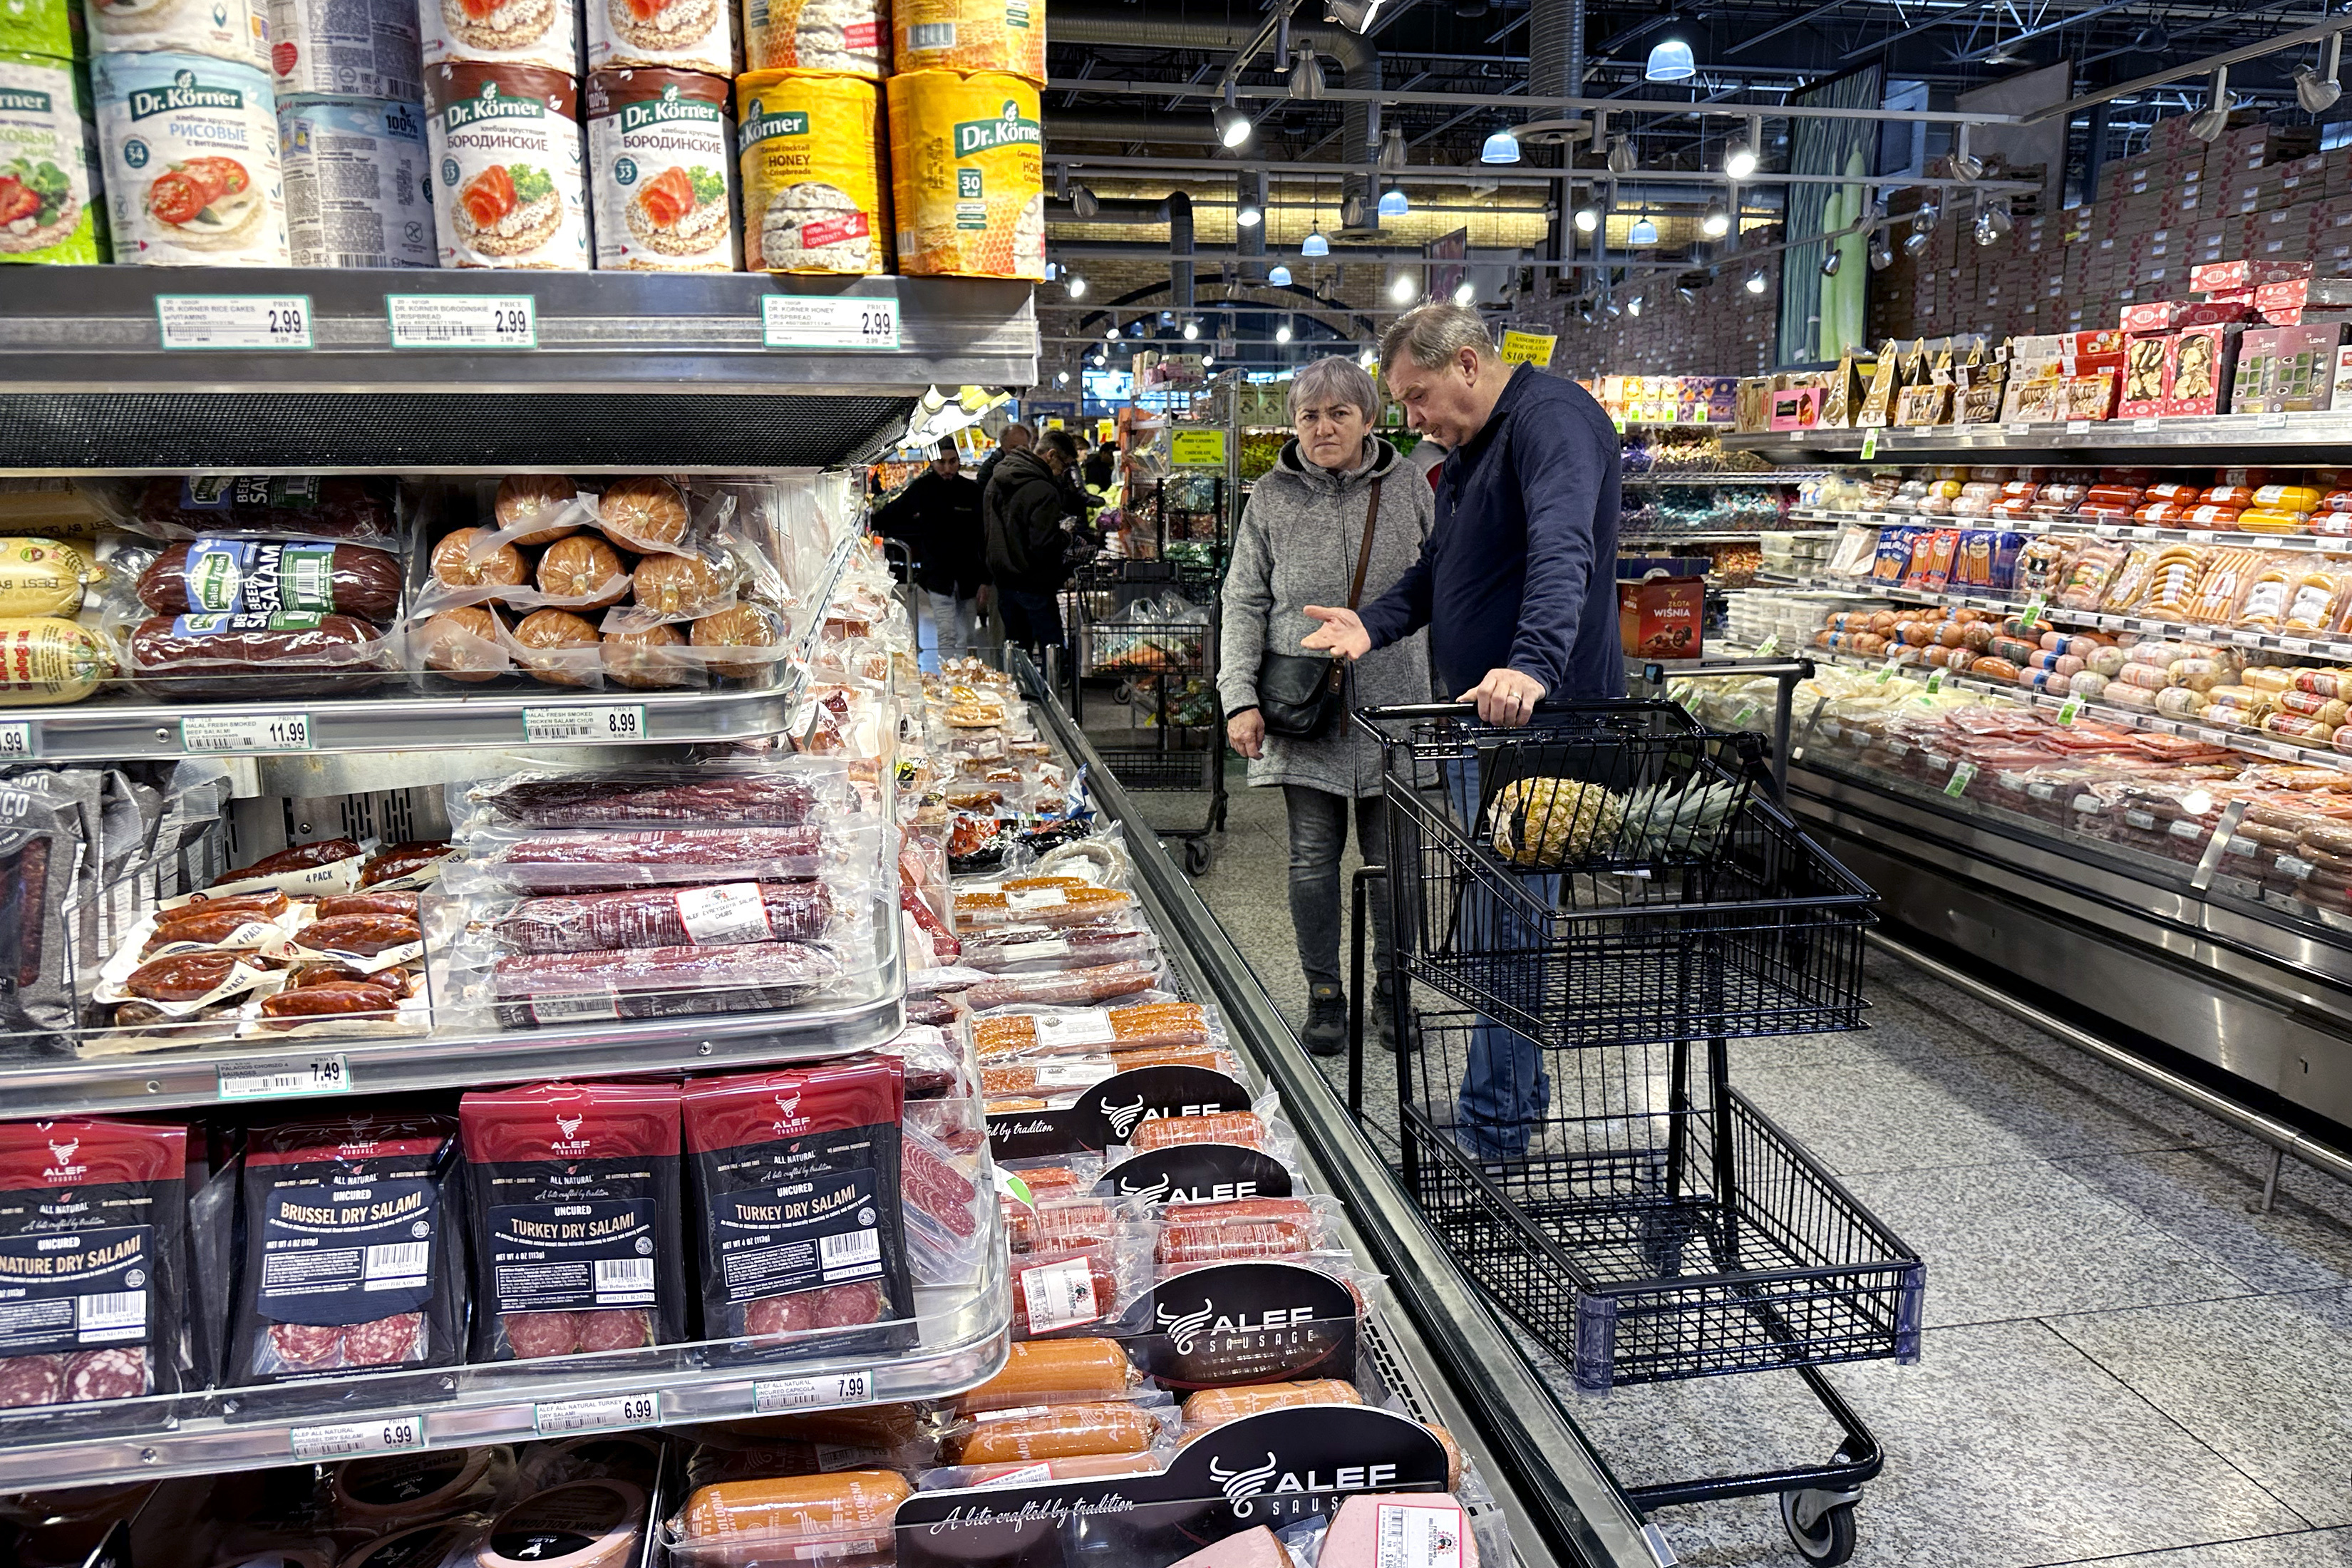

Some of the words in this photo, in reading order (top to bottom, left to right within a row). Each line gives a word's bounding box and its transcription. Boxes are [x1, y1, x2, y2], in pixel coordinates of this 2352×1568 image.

[135, 94, 166, 115] Dr.
[167, 88, 239, 108] Körner
[448, 105, 471, 124] Dr.
[474, 100, 540, 118] Körner
[626, 105, 654, 128] Dr.
[654, 99, 716, 121] Körner
[170, 123, 248, 142] РИСОВЫЕ
[386, 115, 418, 133] 100%
[480, 125, 507, 134] хлебцы
[507, 126, 547, 136] хрустящие
[746, 116, 803, 140] Körner
[194, 139, 249, 151] витаминами
[447, 135, 549, 152] БОРОДИНСКИЕ
[624, 135, 722, 155] БОРОДИНСКИЕ
[963, 126, 994, 151] Dr.
[996, 122, 1041, 143] Körner
[128, 148, 145, 160] 34
[760, 145, 781, 154] Cereal
[782, 143, 810, 153] cocktail
[768, 155, 810, 167] HONEY
[443, 165, 456, 177] 33
[619, 164, 633, 180] 33
[769, 167, 812, 176] Crispbreads
[806, 226, 822, 236] HIGH
[269, 310, 301, 333] 2.99
[495, 310, 526, 333] 2.99
[862, 312, 891, 334] 2.99
[237, 478, 249, 502] BEEF
[21, 578, 59, 589] BEST
[207, 583, 220, 608] Halal
[245, 581, 262, 611] BEEF
[1654, 607, 1691, 618] WIŚNIA
[14, 630, 33, 691] Bologna
[609, 713, 635, 732] 8.99
[269, 723, 305, 742] 11.99
[313, 870, 334, 882] PACK
[702, 903, 736, 917] EVREYSKAYA
[715, 909, 733, 919] CHUBS
[237, 937, 245, 946] 4
[243, 924, 264, 942] PACK
[227, 974, 248, 991] PACK
[311, 1062, 340, 1081] 7.49
[772, 1117, 811, 1130] ALEF
[777, 1126, 807, 1135] SAUSAGE
[999, 1121, 1012, 1143] by
[1013, 1120, 1054, 1135] tradition
[339, 1141, 378, 1150] ALEF
[551, 1141, 591, 1150] ALEF
[773, 1155, 786, 1165] ALL
[787, 1150, 815, 1163] NATURAL
[43, 1166, 88, 1176] ALEF
[333, 1176, 346, 1185] ALL
[347, 1175, 377, 1185] NATURAL
[550, 1175, 563, 1185] ALL
[564, 1175, 592, 1185] NATURAL
[333, 1189, 372, 1202] UNCURED
[777, 1182, 813, 1197] UNCURED
[1168, 1181, 1257, 1204] ALEF
[39, 1204, 53, 1213] ALL
[53, 1202, 88, 1214] NATURAL
[281, 1202, 338, 1224] BRUSSEL
[341, 1207, 368, 1224] DRY
[370, 1191, 422, 1221] SALAMI
[555, 1205, 592, 1217] UNCURED
[736, 1204, 782, 1222] TURKEY
[785, 1201, 809, 1220] DRY
[811, 1183, 856, 1214] SALAMI
[511, 1218, 558, 1239] TURKEY
[562, 1223, 585, 1239] DRY
[589, 1212, 634, 1237] SALAMI
[37, 1237, 81, 1250] UNCURED
[755, 1234, 770, 1245] (113g)
[56, 1254, 85, 1273] DRY
[88, 1234, 141, 1269] SALAMI
[1209, 1306, 1314, 1336] ALEF
[1209, 1329, 1314, 1353] SAUSAGE
[785, 1386, 815, 1394] CAPICOLA
[839, 1378, 864, 1397] 7.99
[624, 1400, 651, 1419] 6.99
[384, 1425, 412, 1445] 6.99
[1274, 1463, 1396, 1494] ALEF
[929, 1506, 962, 1535] A
[965, 1506, 992, 1527] bite
[996, 1498, 1049, 1533] crafted
[1051, 1498, 1069, 1530] by
[1073, 1492, 1135, 1517] tradition
